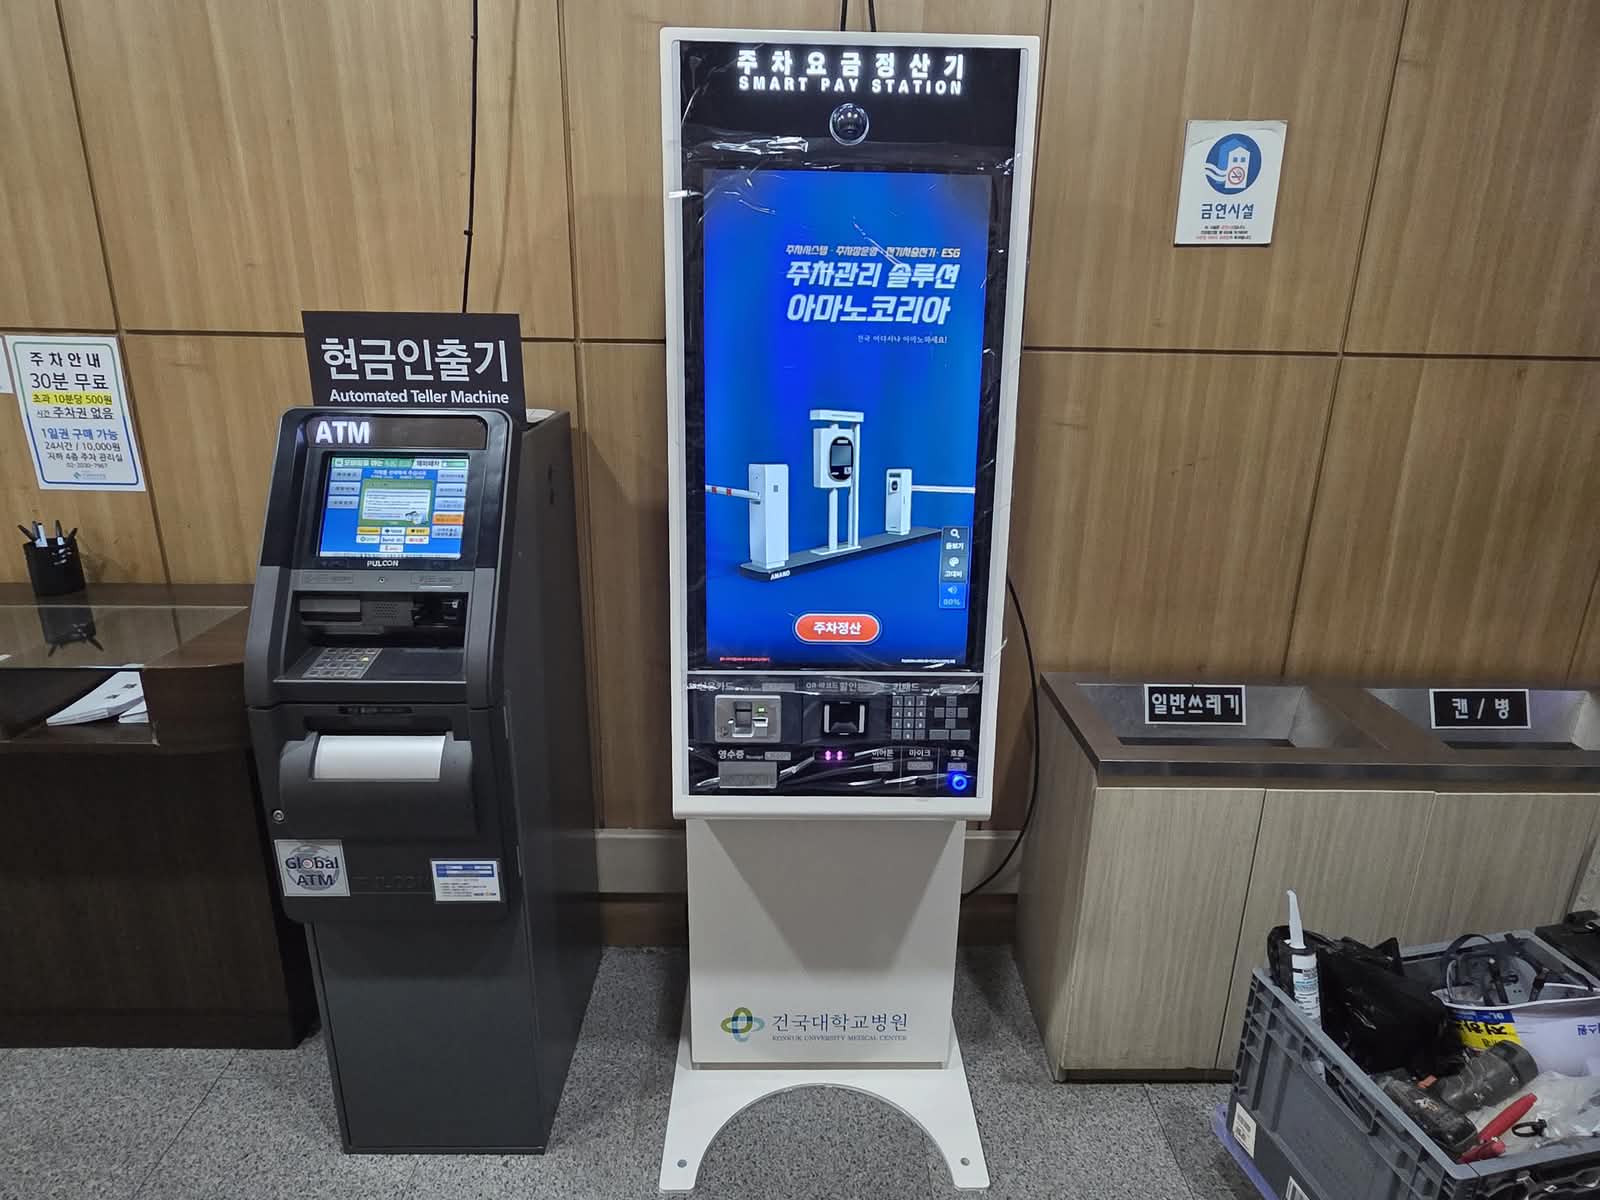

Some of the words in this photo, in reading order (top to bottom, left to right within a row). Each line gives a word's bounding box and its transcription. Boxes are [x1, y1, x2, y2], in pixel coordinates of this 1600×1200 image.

[738, 75, 808, 92] SMART
[820, 77, 859, 92] PAY
[871, 78, 963, 95] STATION
[1201, 203, 1255, 220] 금연시설
[941, 248, 961, 258] ESG
[786, 260, 882, 288] 주차관리
[886, 262, 961, 289] 솔루션
[786, 293, 951, 325] 아마노코리아
[321, 338, 508, 382] 현금인출기
[30, 373, 69, 390] 30분
[74, 373, 109, 391] 무료
[54, 395, 82, 405] 10분당
[85, 395, 112, 405] 500원
[330, 389, 408, 403] Automated
[411, 390, 447, 403] Teller
[451, 391, 509, 404] Machine
[53, 406, 87, 419] 주차권
[90, 408, 113, 420] 없음
[41, 428, 69, 440] 1일권
[72, 429, 94, 440] 구매
[96, 429, 118, 441] 가능
[315, 421, 371, 444] ATM
[45, 442, 73, 451] 24시간
[82, 442, 121, 452] 10,000원
[813, 621, 863, 635] 주차정산
[1151, 693, 1240, 716] 일반쓰레기
[1477, 698, 1486, 720] /
[1494, 698, 1510, 719] 병
[718, 749, 745, 760] 영수증
[909, 749, 931, 757] 마이크
[286, 857, 339, 870] Global
[297, 875, 334, 887] ATM
[772, 1013, 908, 1033] 건국대학교병원
